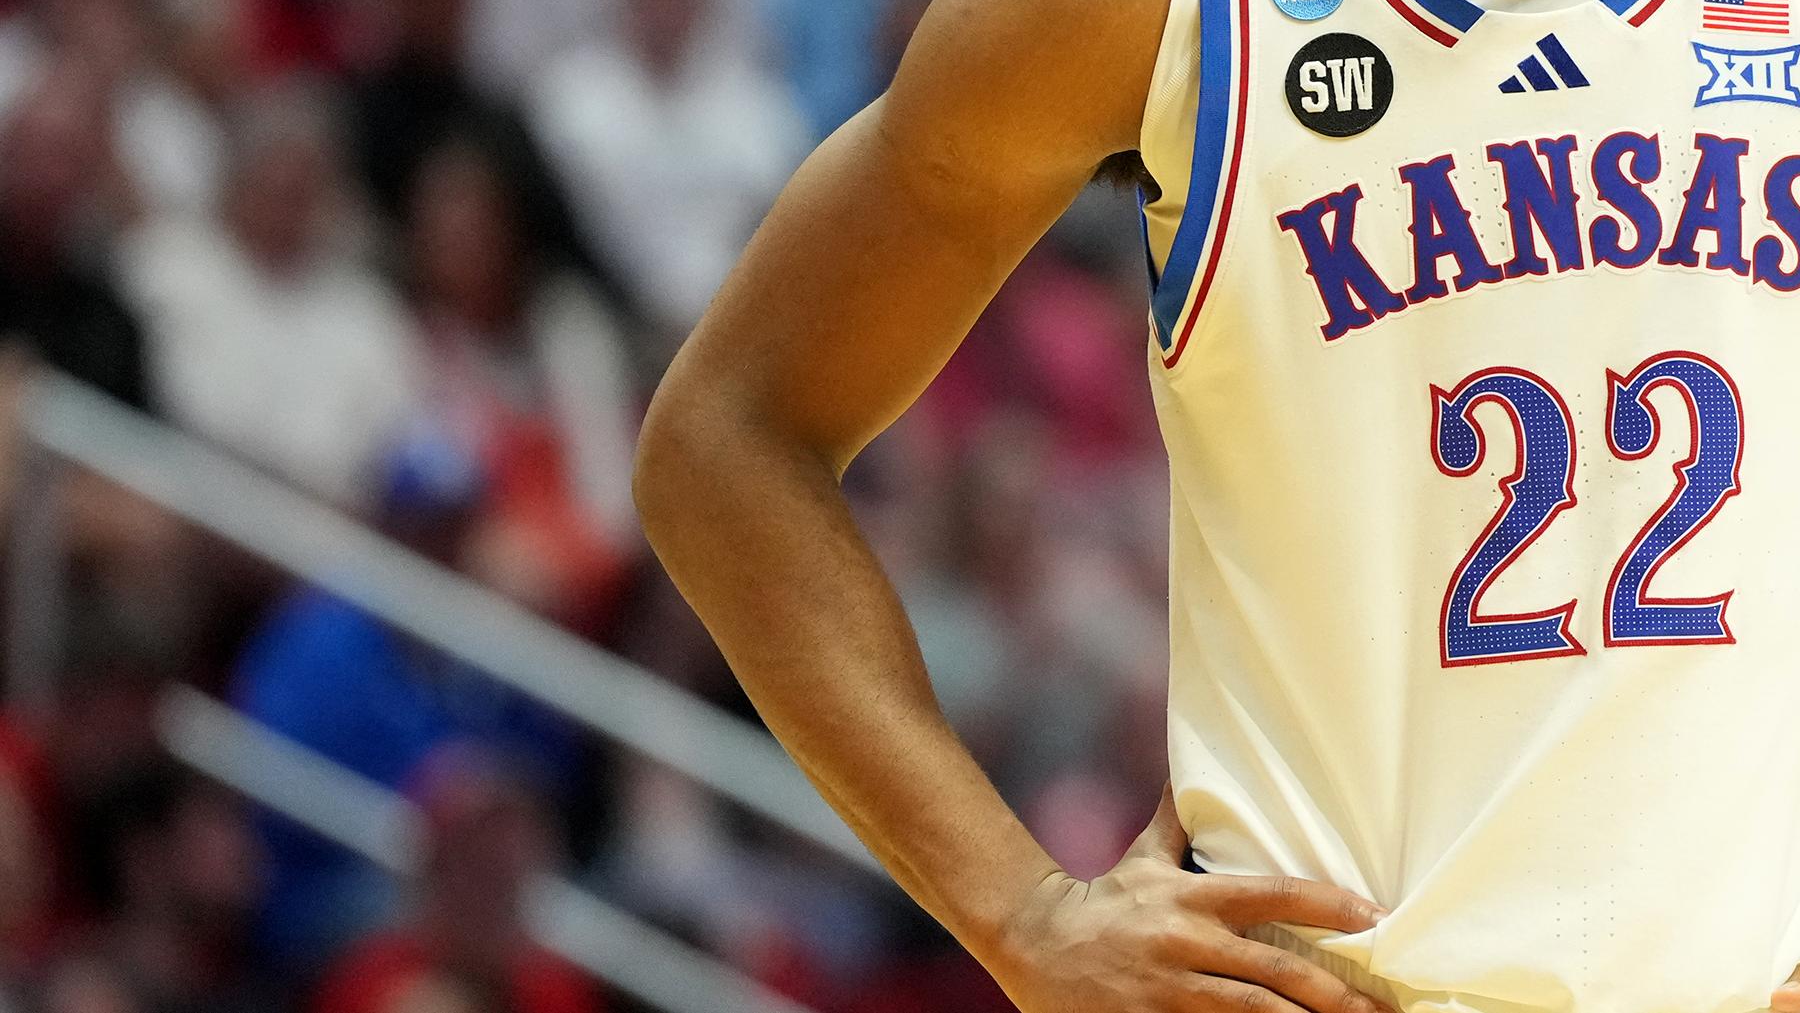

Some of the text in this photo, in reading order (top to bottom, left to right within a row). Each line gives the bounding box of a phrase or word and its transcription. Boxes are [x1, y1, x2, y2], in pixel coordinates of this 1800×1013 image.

[1299, 56, 1376, 113] SW
[1698, 48, 1799, 103] XII
[1429, 350, 1745, 668] 22
